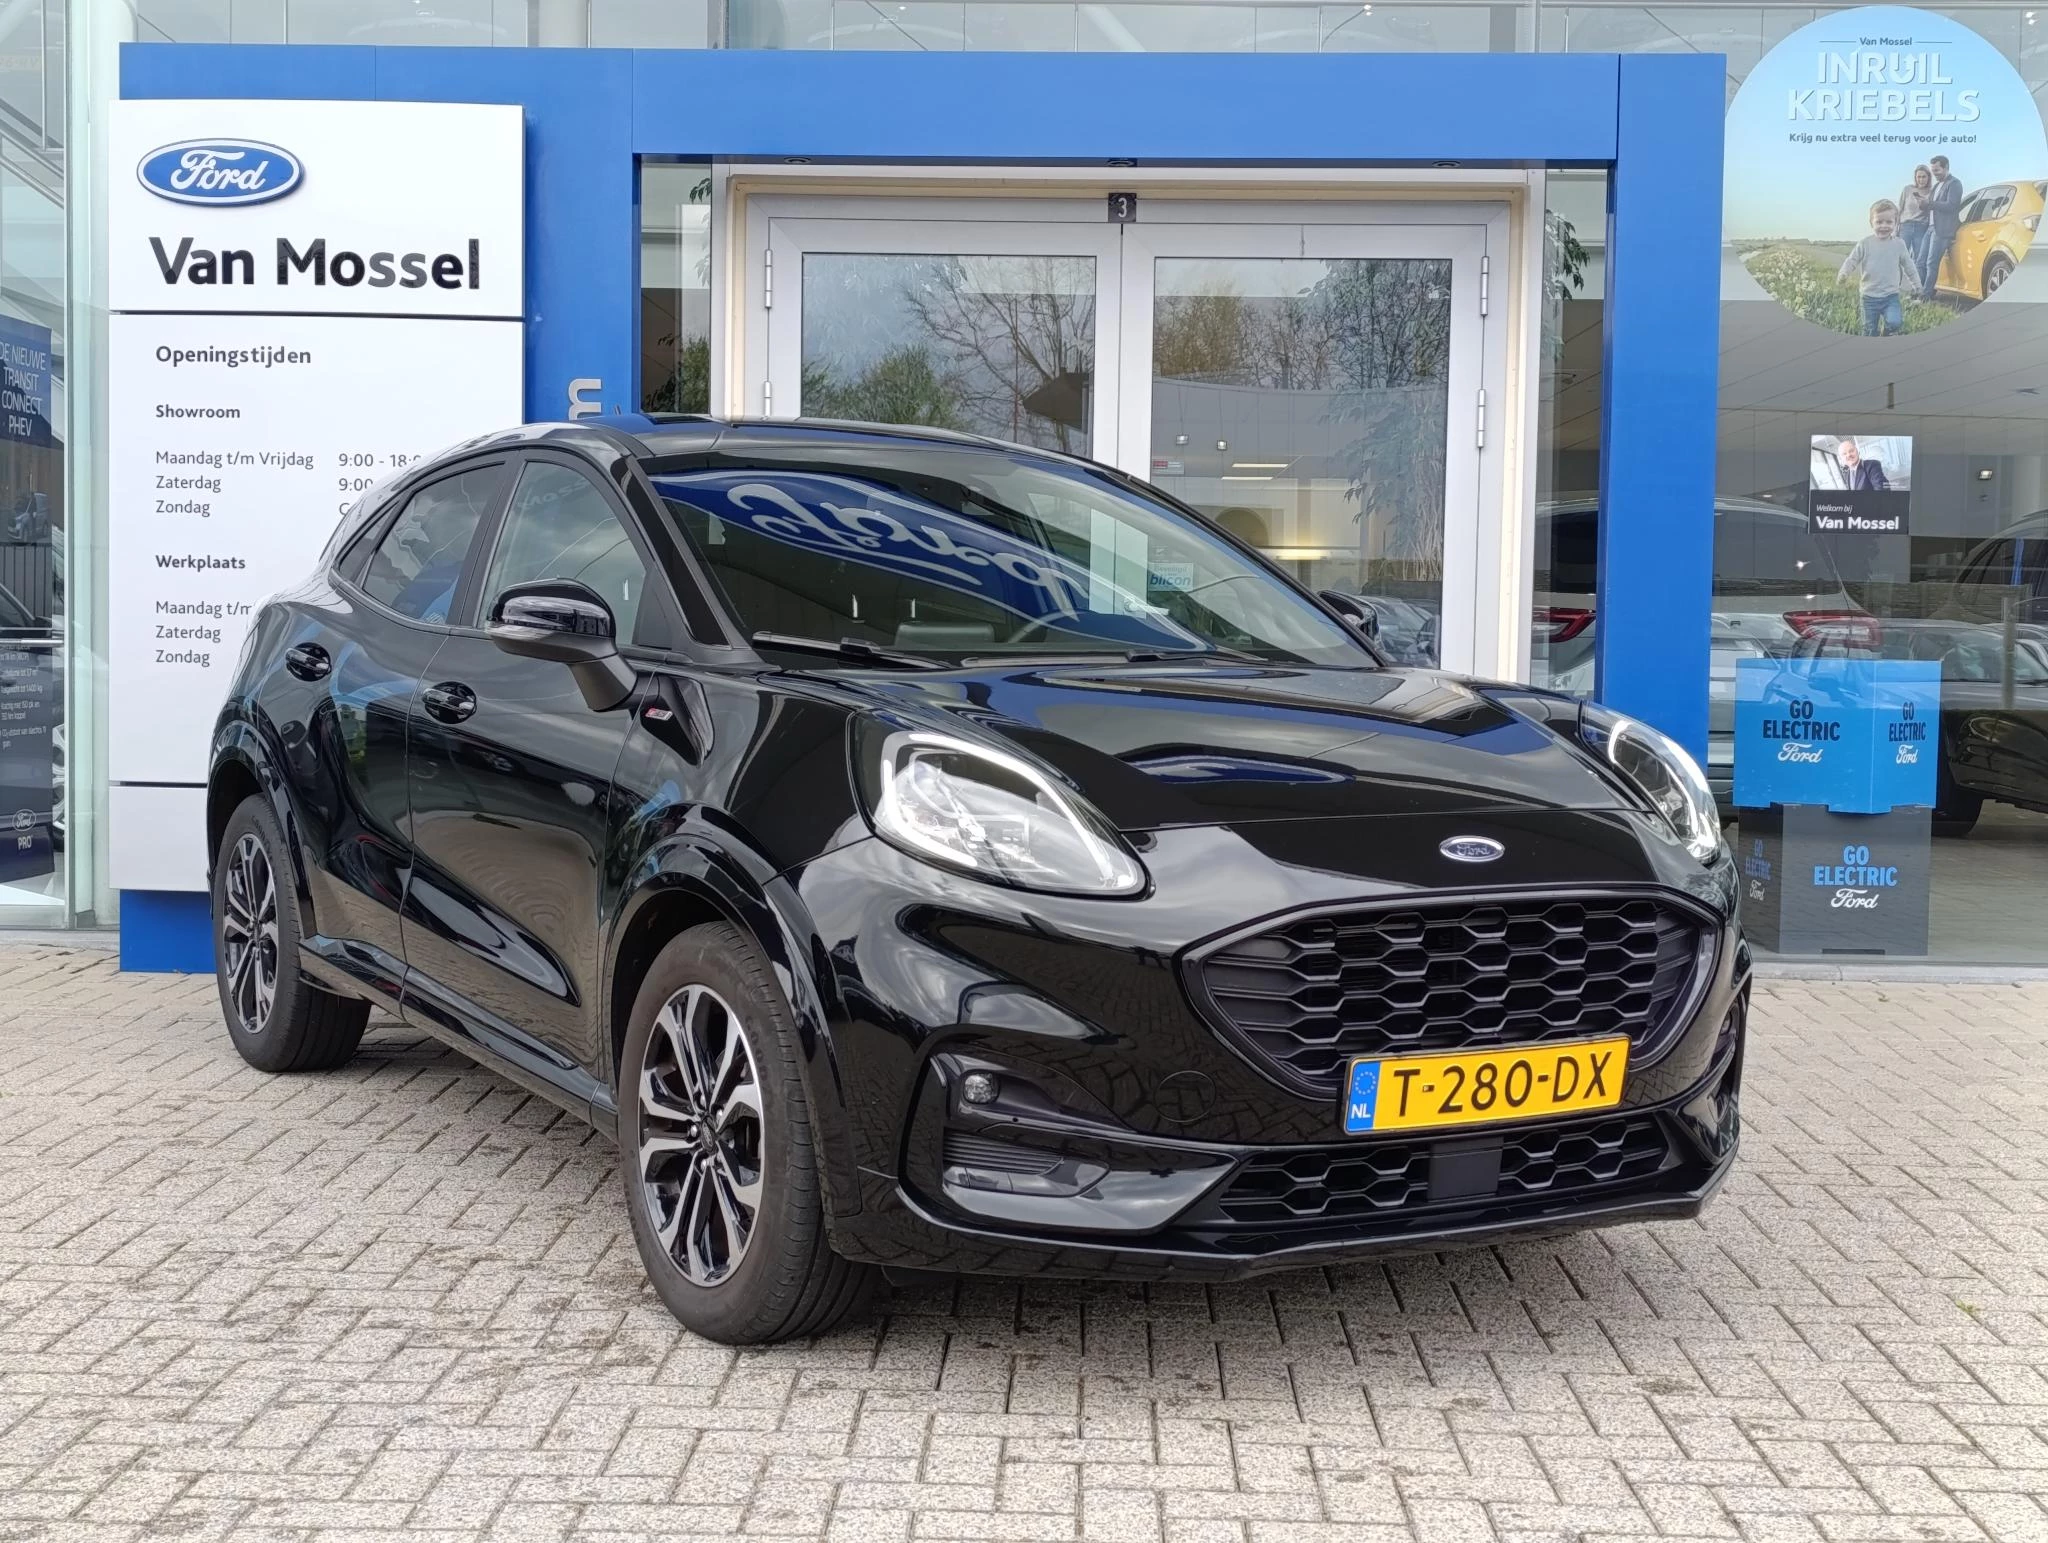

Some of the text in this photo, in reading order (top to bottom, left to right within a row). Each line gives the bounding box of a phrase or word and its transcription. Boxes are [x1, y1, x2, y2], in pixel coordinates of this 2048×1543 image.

[1859, 36, 1913, 46] Van Mossel
[1817, 51, 1953, 85] INRUIL
[1788, 89, 1981, 122] KRIEBELS
[1789, 133, 1977, 144] Krijg nu extra veel terug voor je auto!
[170, 149, 269, 190] Ford
[1118, 197, 1128, 218] 3
[148, 236, 480, 290] Van Mossel
[11, 346, 47, 371] NIEUWE
[155, 345, 312, 368] Openingstijden
[3, 366, 40, 392] TRANSIT
[1, 390, 43, 416] CONNECT
[155, 404, 241, 419] Showroom
[8, 415, 33, 437] PHEV
[155, 451, 223, 469] Maandag
[227, 451, 255, 467] t/m
[259, 452, 314, 470] Vrijdag
[338, 453, 374, 467] 9:00
[155, 475, 222, 493] Zaterdag
[155, 500, 211, 518] Zondag
[1816, 504, 1843, 512] Welkom
[1815, 516, 1899, 530] Van Mossel
[155, 554, 246, 573] Werkplaats
[1150, 573, 1192, 586] blicon
[155, 601, 223, 619] Maandag
[155, 625, 222, 643] Zaterdag
[155, 649, 210, 668] Zondag
[1790, 700, 1814, 720] GO
[1902, 702, 1914, 720] GO
[1763, 719, 1840, 741] ELECTRIC
[1888, 722, 1926, 742] ELECTRIC
[1777, 742, 1824, 763] Ford
[1895, 744, 1918, 764] Ford
[17, 835, 32, 850] PRO
[1843, 845, 1870, 865] GO
[1813, 866, 1898, 887] ELECTRIC
[1830, 887, 1880, 909] Ford
[1351, 1051, 1613, 1119] NL T-280-DX
